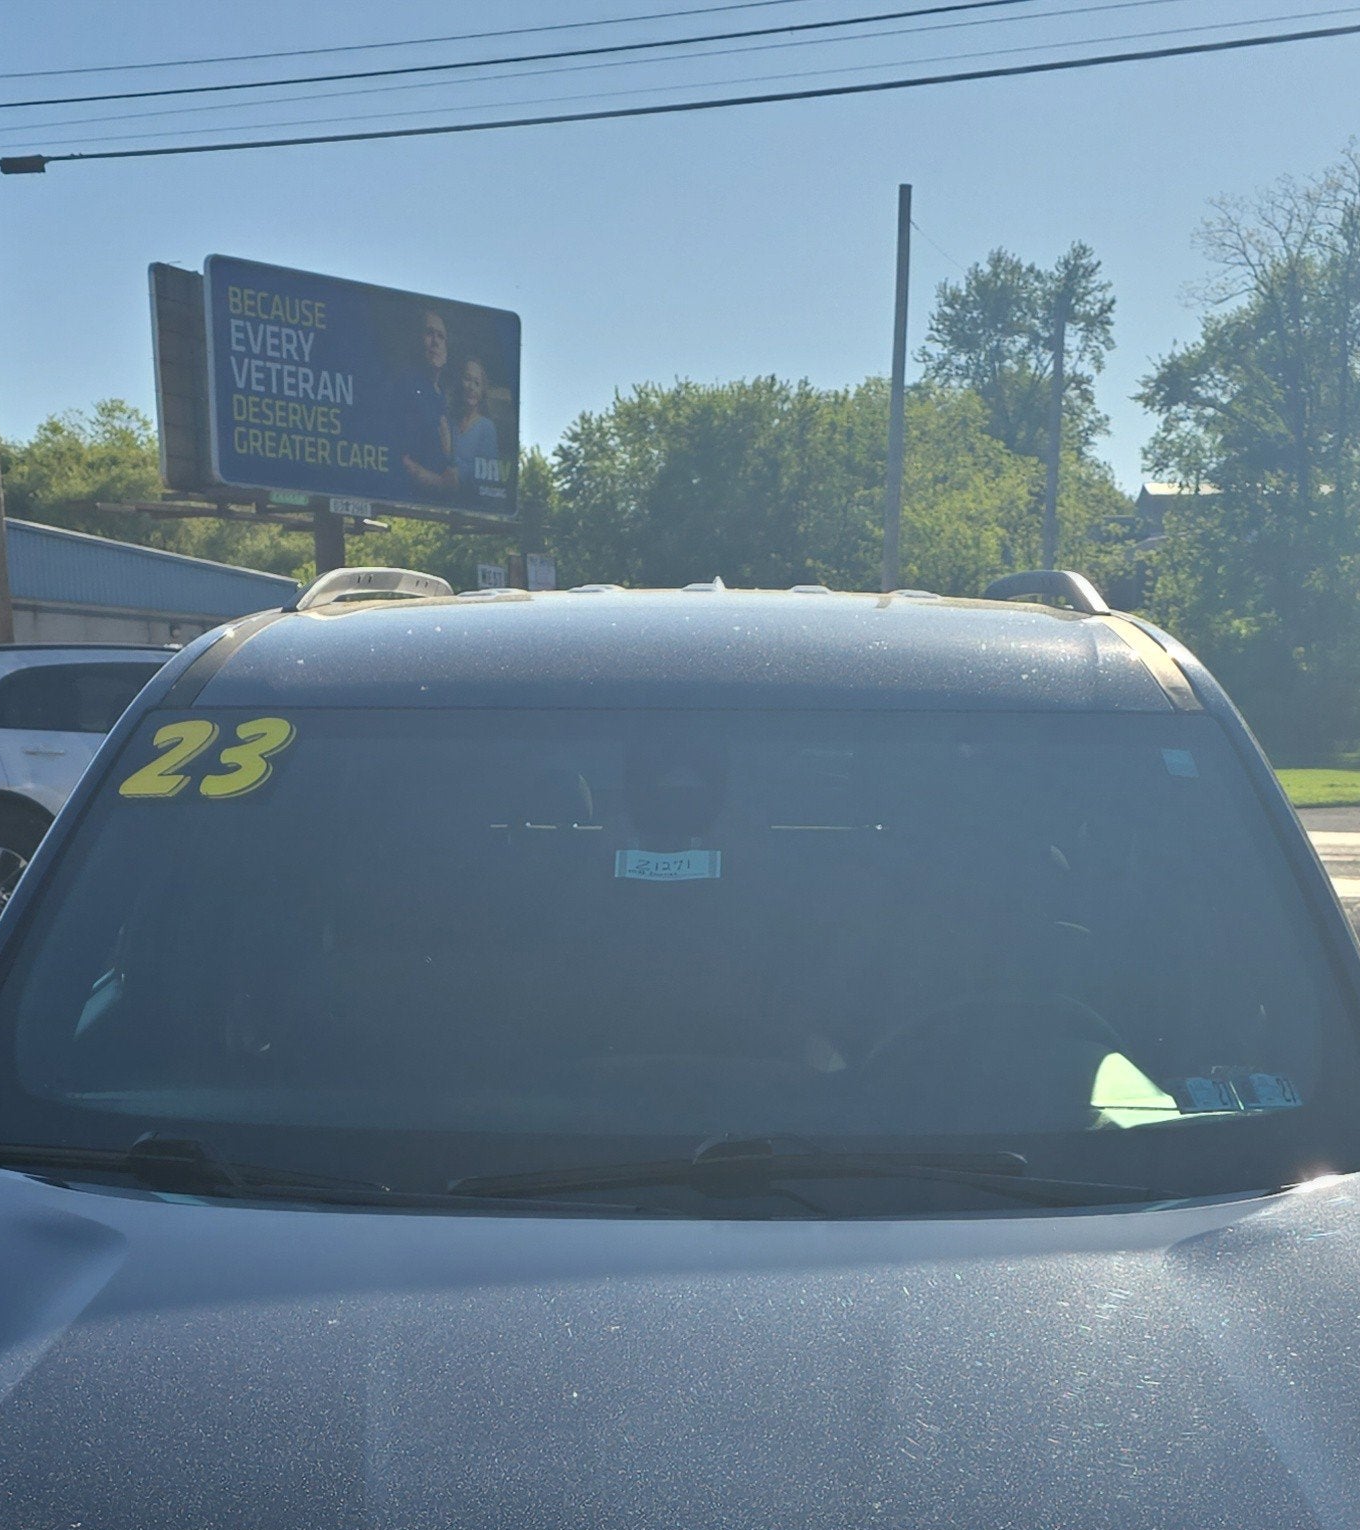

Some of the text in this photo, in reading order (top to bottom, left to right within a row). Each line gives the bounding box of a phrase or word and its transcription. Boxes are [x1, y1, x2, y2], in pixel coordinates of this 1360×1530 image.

[228, 286, 326, 329] BECAUSE
[230, 318, 314, 363] EVERY
[230, 355, 354, 405] VETERAN
[232, 393, 341, 435] DESERVES
[233, 426, 389, 472] GREATER CARE
[119, 717, 297, 798] 23
